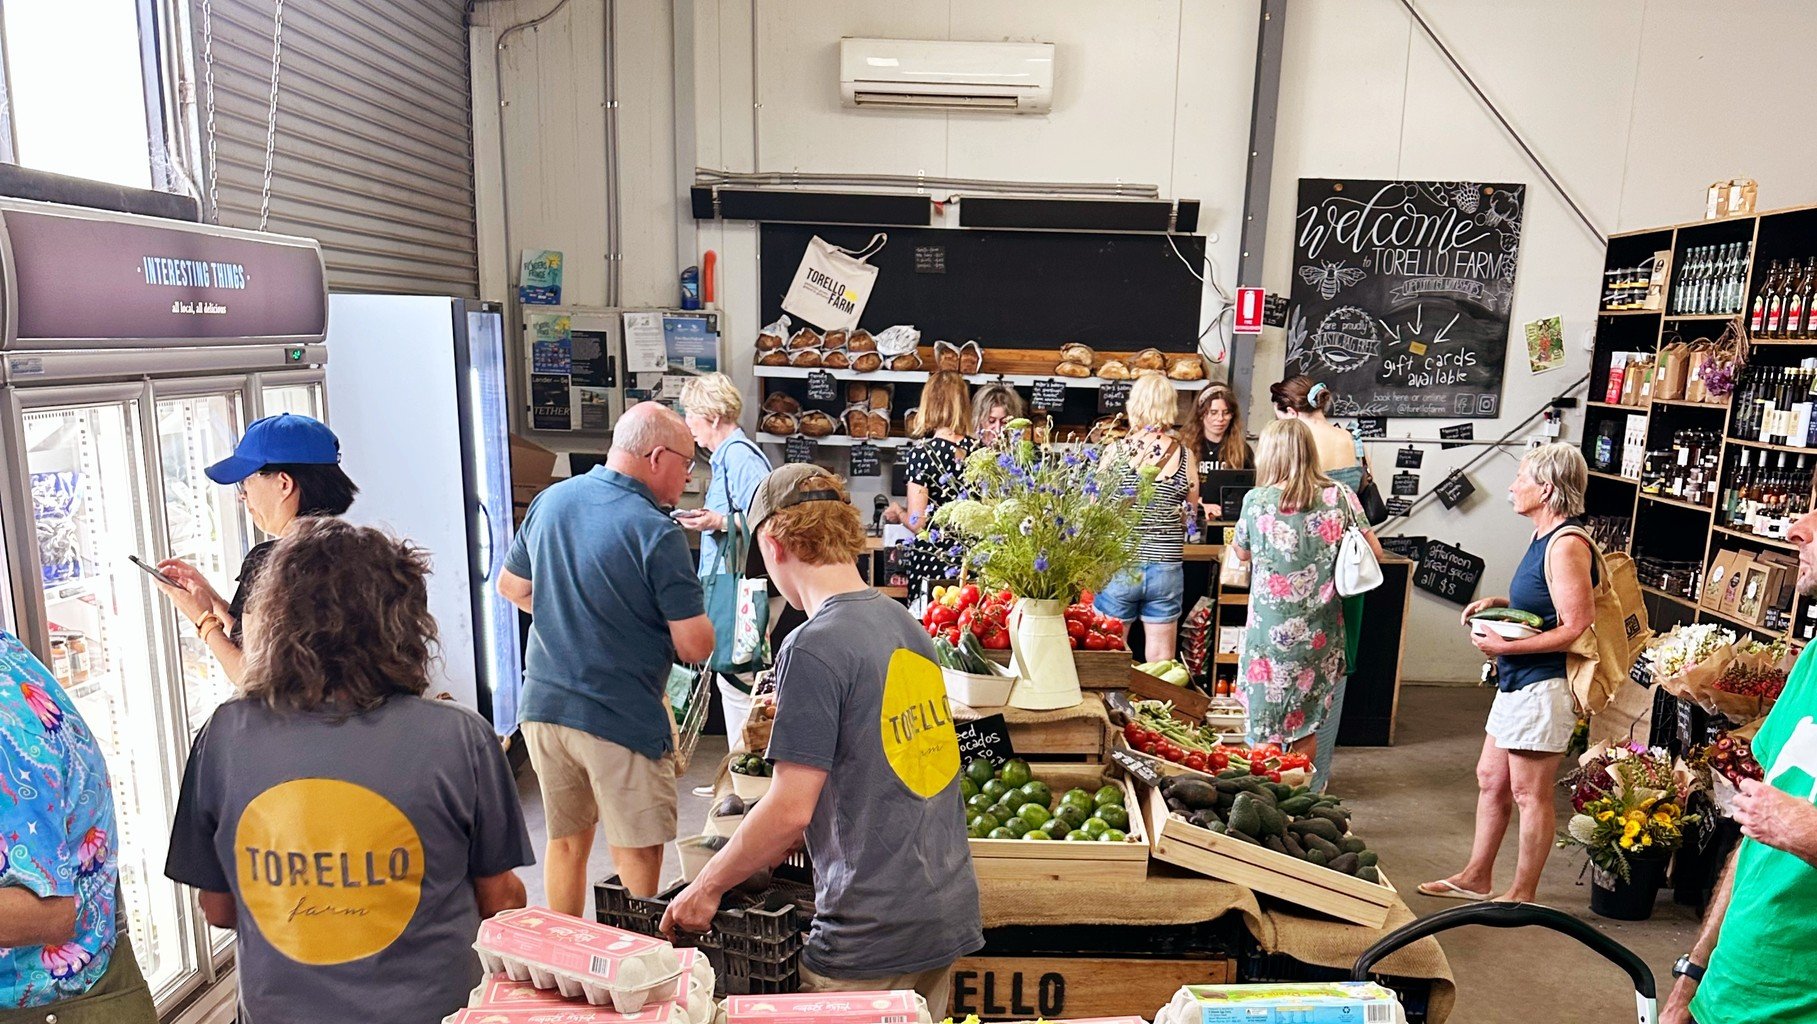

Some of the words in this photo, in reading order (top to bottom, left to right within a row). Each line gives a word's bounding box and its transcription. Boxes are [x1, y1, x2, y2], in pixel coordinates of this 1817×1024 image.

[1297, 184, 1490, 258] welcome
[143, 256, 210, 288] INTERESTING
[211, 262, 245, 289] THINGS
[1363, 257, 1371, 268] to
[1372, 248, 1448, 277] TORELLO
[1453, 250, 1503, 279] FARM
[806, 267, 846, 296] TORELLO
[180, 301, 195, 315] local,
[204, 302, 227, 314] delicious
[828, 292, 855, 315] FARM
[1324, 322, 1337, 330] are
[1342, 320, 1367, 335] proudly
[1383, 355, 1414, 377] gift
[1424, 347, 1477, 370] cards
[1408, 370, 1467, 387] available
[1392, 392, 1409, 401] here
[1421, 394, 1447, 402] online
[1429, 543, 1471, 569] afternoon
[1420, 571, 1436, 587] all
[1439, 577, 1457, 595] $8
[1423, 556, 1449, 573] bread
[1448, 567, 1479, 585] special
[889, 694, 953, 744] TOELLO
[245, 847, 410, 888] TORELLO
[288, 896, 369, 923] farm
